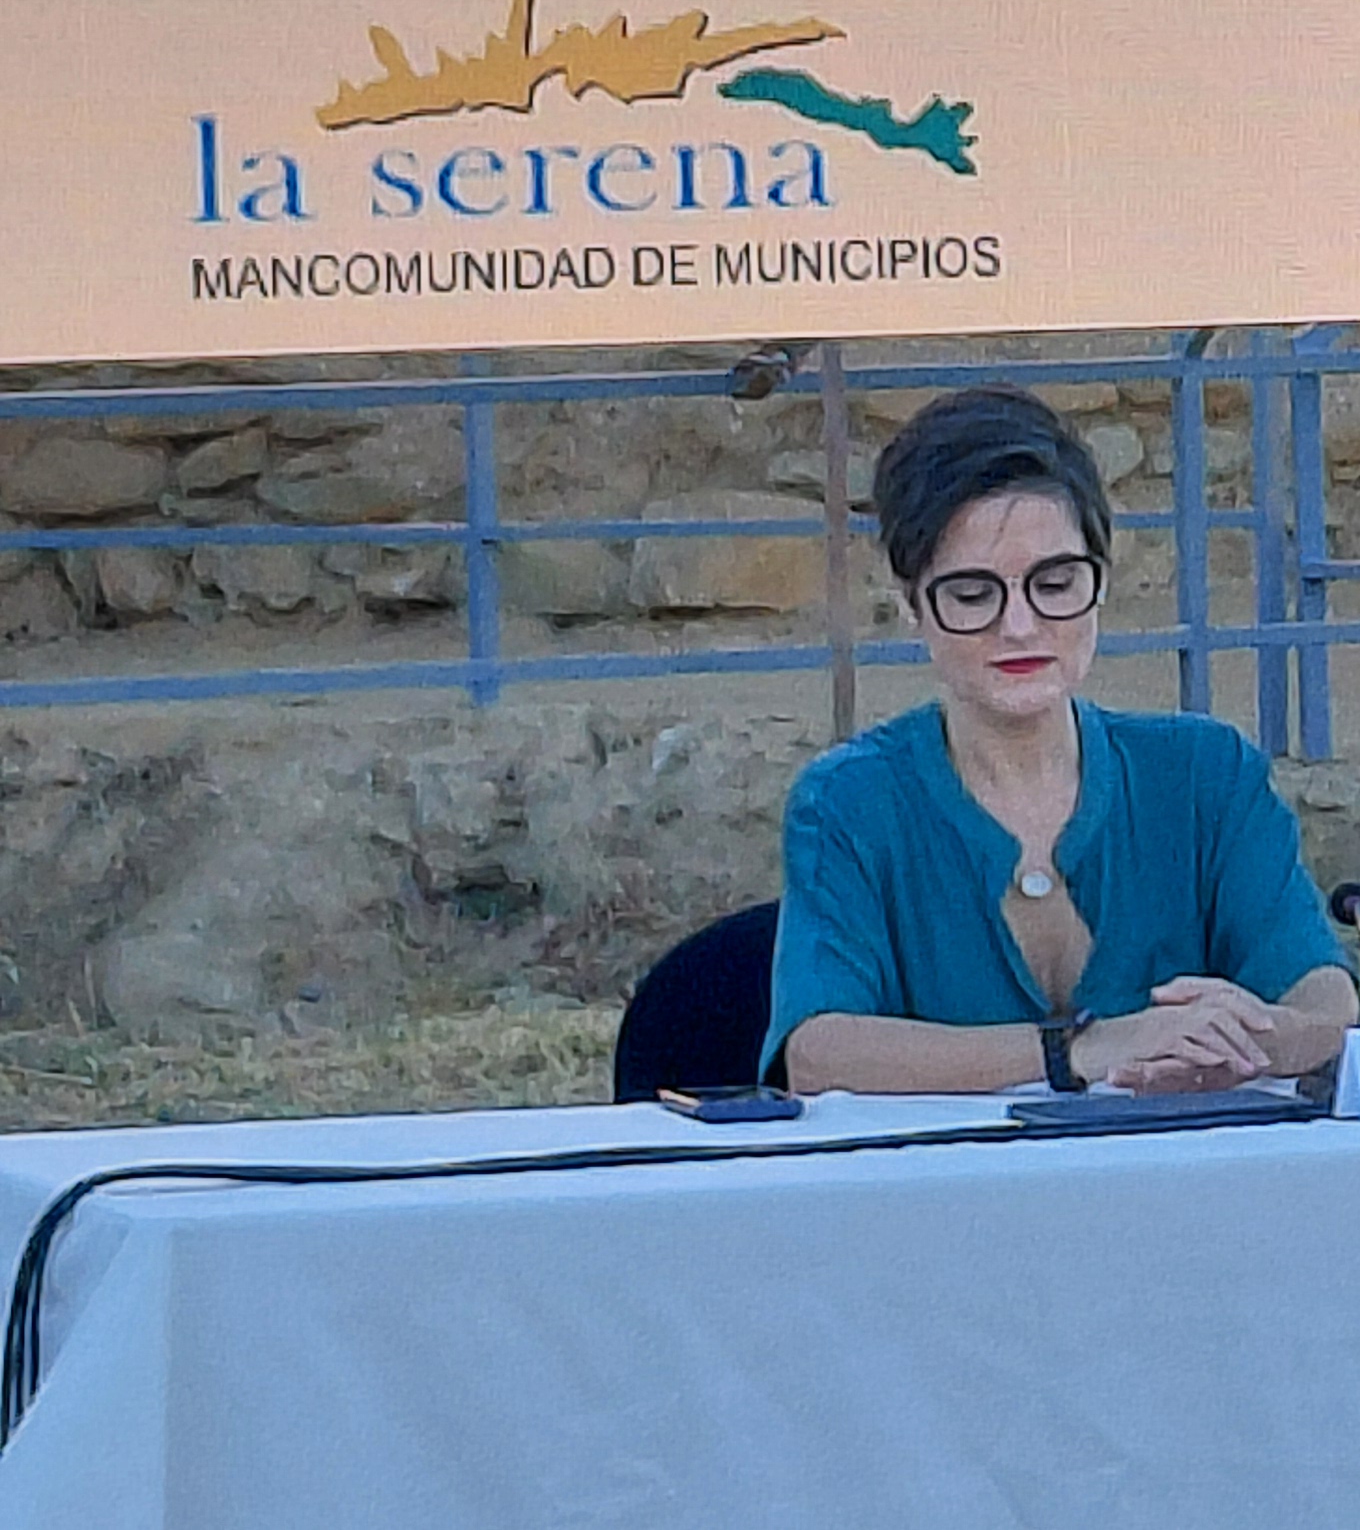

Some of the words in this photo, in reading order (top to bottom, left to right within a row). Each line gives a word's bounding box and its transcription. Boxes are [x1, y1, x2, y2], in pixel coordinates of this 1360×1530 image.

[190, 113, 314, 224] la
[370, 135, 838, 218] serena
[191, 247, 616, 300] MANCOMUNIDAD
[631, 244, 699, 287] DE
[715, 235, 1001, 287] MUNICIPIOS
